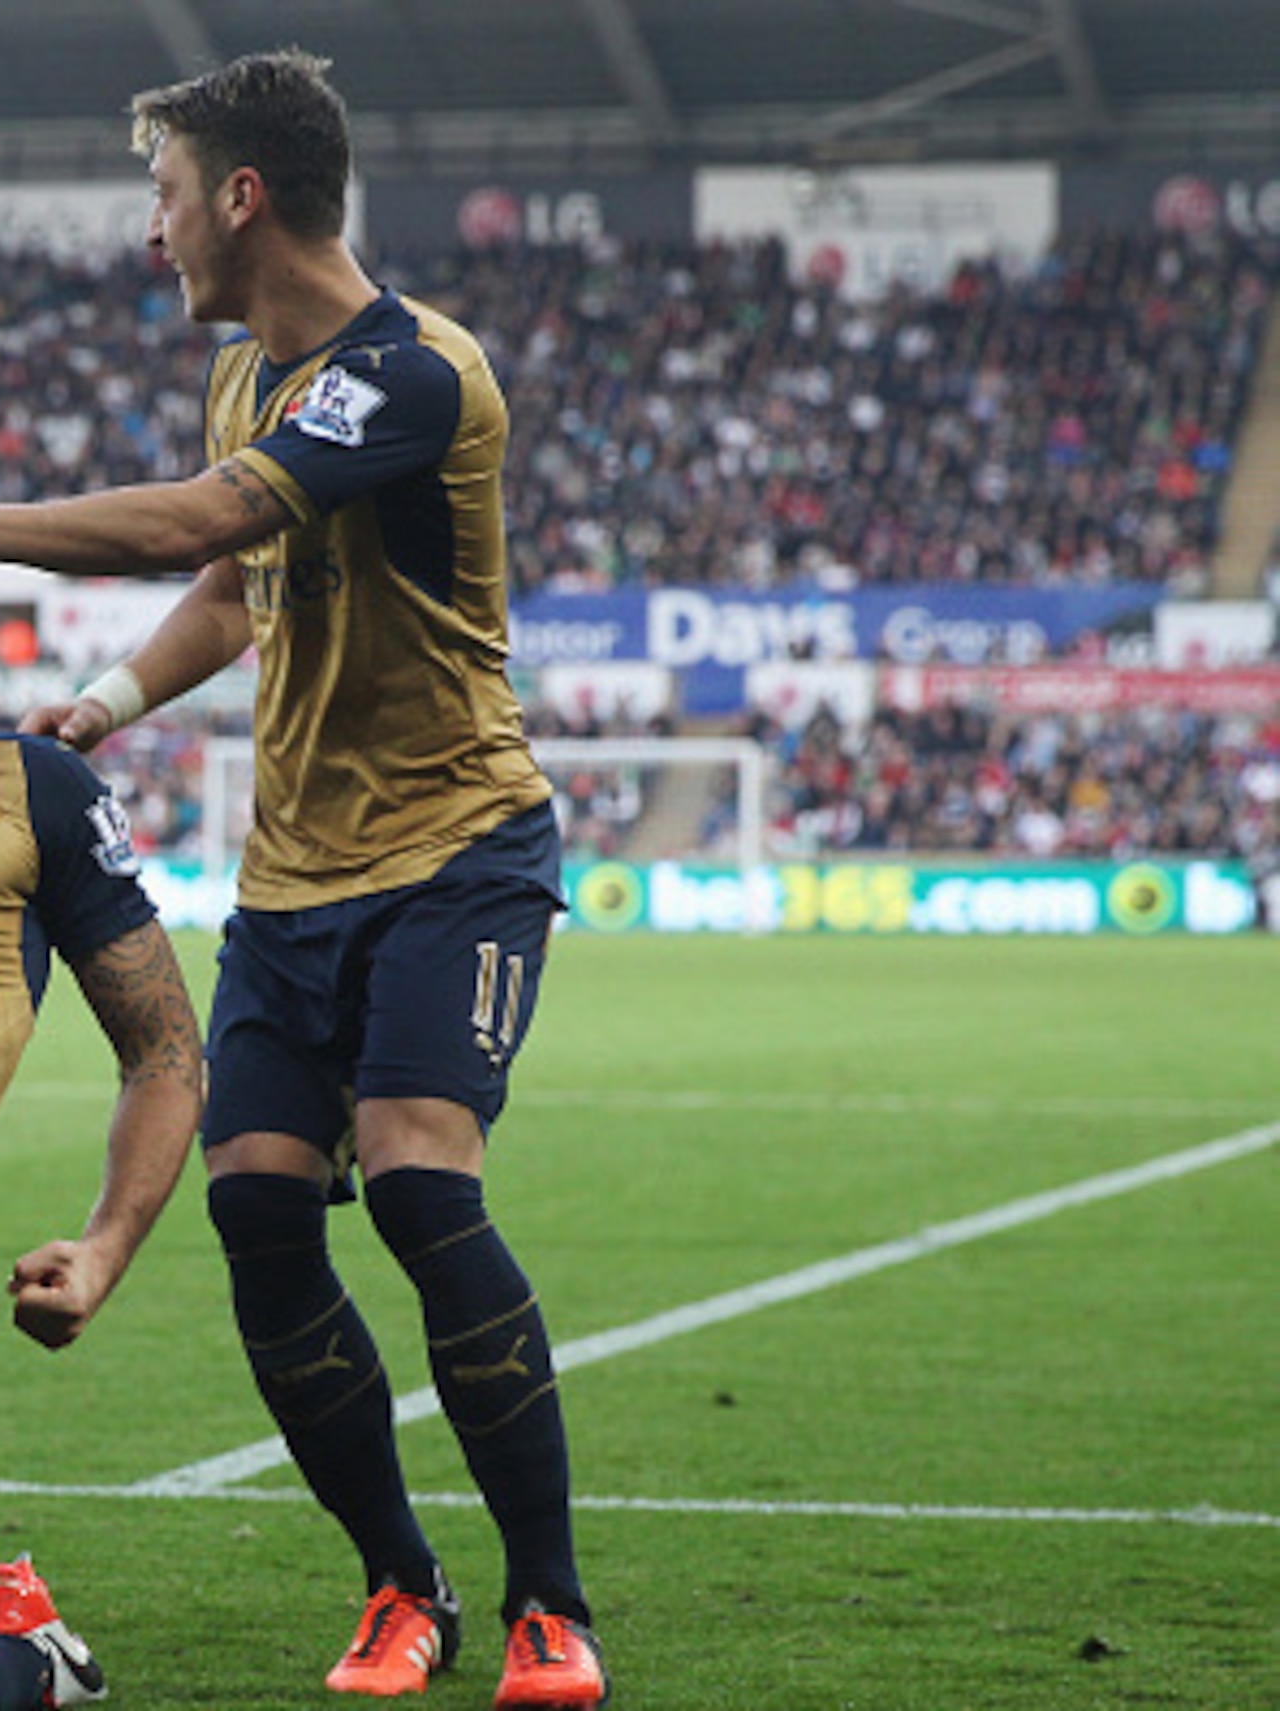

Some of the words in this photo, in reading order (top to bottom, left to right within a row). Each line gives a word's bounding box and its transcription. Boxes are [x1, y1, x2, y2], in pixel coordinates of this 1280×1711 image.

[646, 587, 861, 667] Days
[647, 861, 1102, 932] bet365.com
[471, 940, 524, 1046] 11
